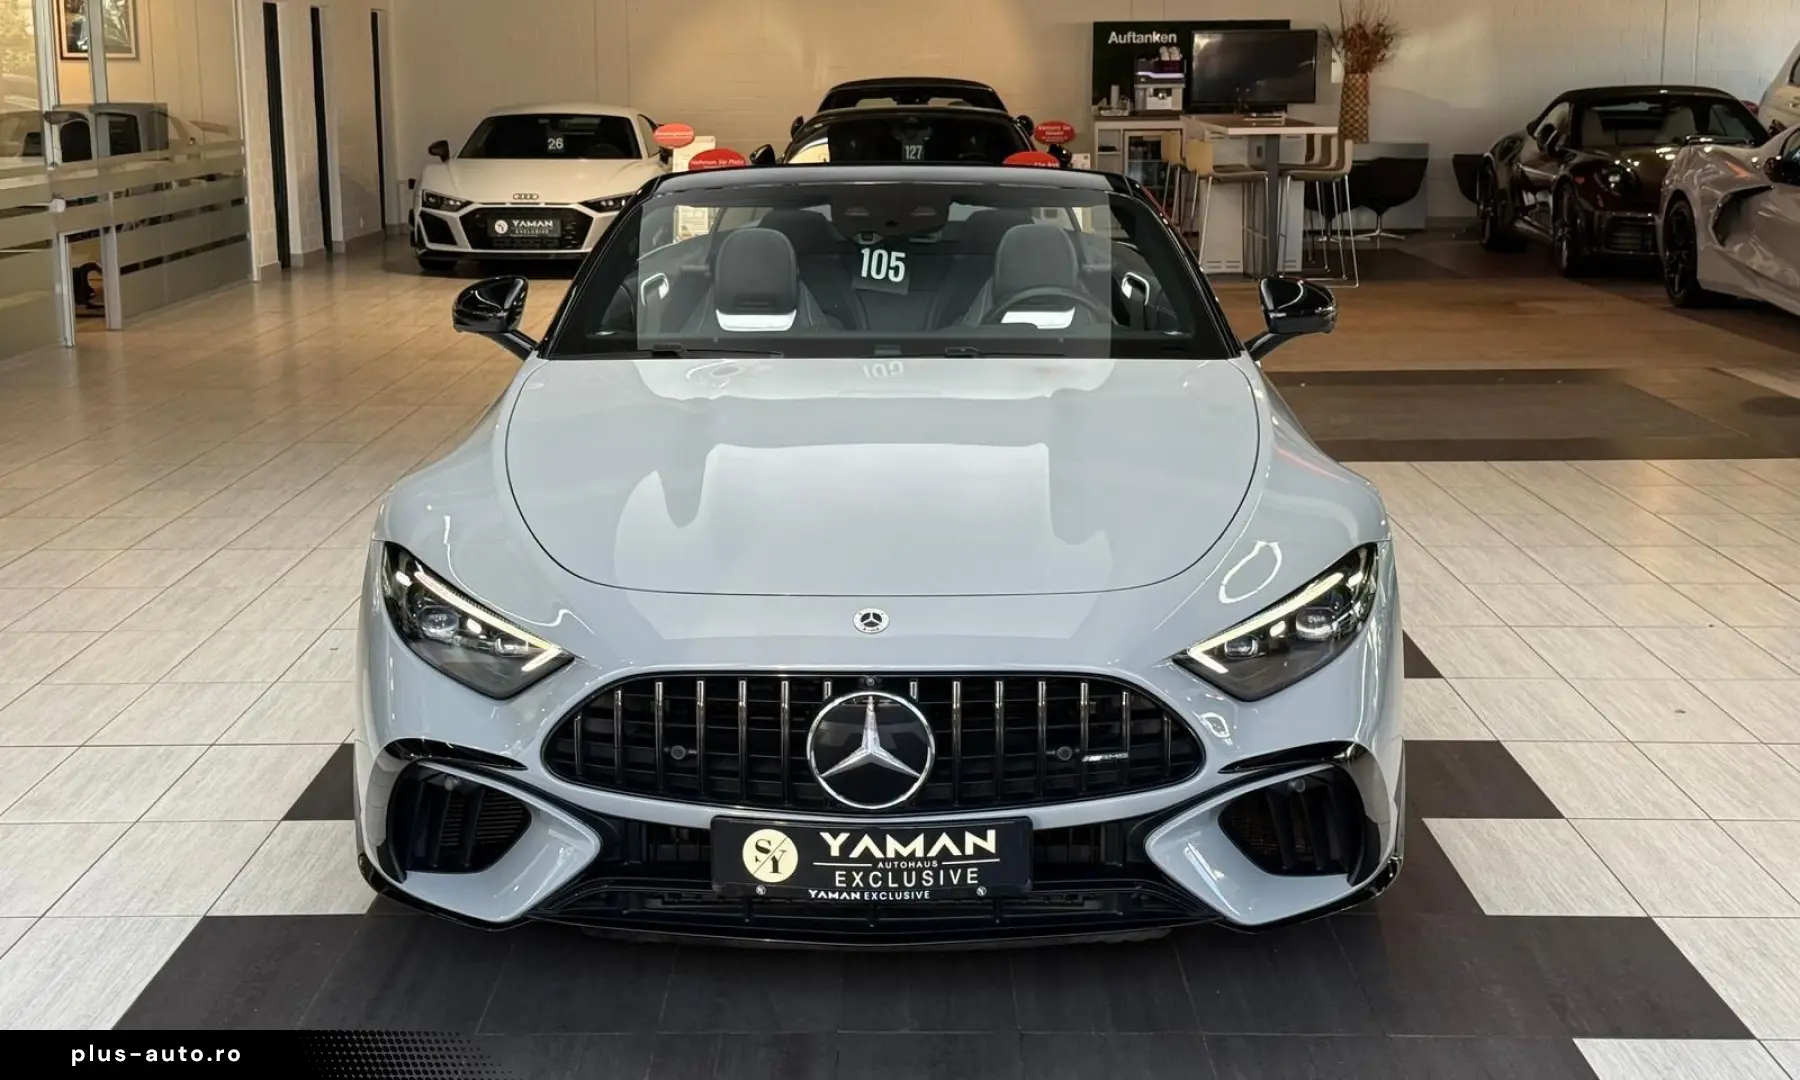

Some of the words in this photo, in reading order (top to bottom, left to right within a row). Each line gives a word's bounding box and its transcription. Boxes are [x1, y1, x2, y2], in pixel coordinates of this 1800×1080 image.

[1108, 31, 1177, 44] Auftanken
[548, 137, 564, 150] 26
[905, 144, 923, 160] 127
[512, 219, 554, 227] YAMAN
[861, 248, 906, 283] 105
[819, 829, 996, 858] YAMAN
[877, 860, 938, 869] AUTOHAUS
[835, 867, 979, 888] EXCLUSIVE
[808, 889, 860, 900] YAMAN
[864, 890, 930, 901] EXCLUSIVE
